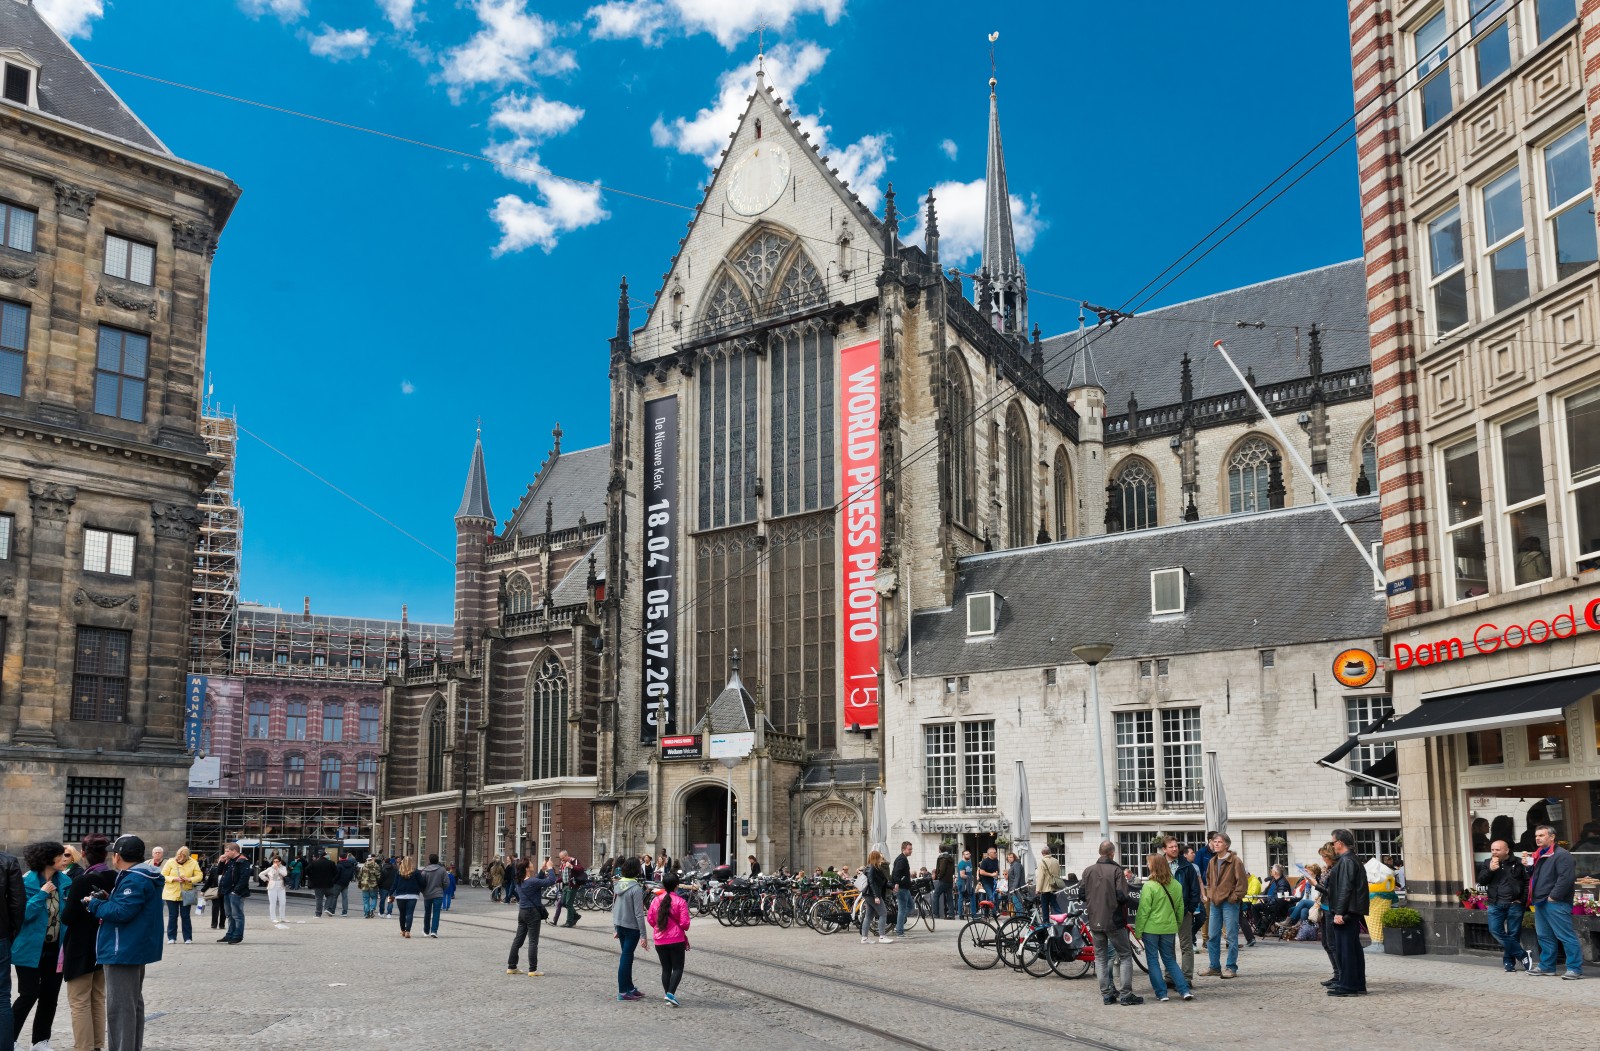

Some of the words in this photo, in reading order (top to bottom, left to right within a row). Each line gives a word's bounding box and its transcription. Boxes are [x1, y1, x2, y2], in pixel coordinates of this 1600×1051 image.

[654, 417, 666, 430] De
[848, 365, 876, 461] WORLD
[653, 431, 666, 467] Nieuwe
[653, 467, 665, 491] Kerk
[848, 465, 877, 547] PRESS
[647, 498, 670, 568] 18.04
[849, 551, 878, 643] PHOTO
[1394, 580, 1405, 588] DAM
[646, 589, 670, 726] 05.07.2015
[1393, 637, 1465, 671] Dam
[1473, 604, 1577, 654] Good
[190, 678, 202, 718] MAGNA
[850, 666, 879, 708] 15
[190, 722, 198, 752] PLAZ
[921, 819, 971, 833] Nieuwe
